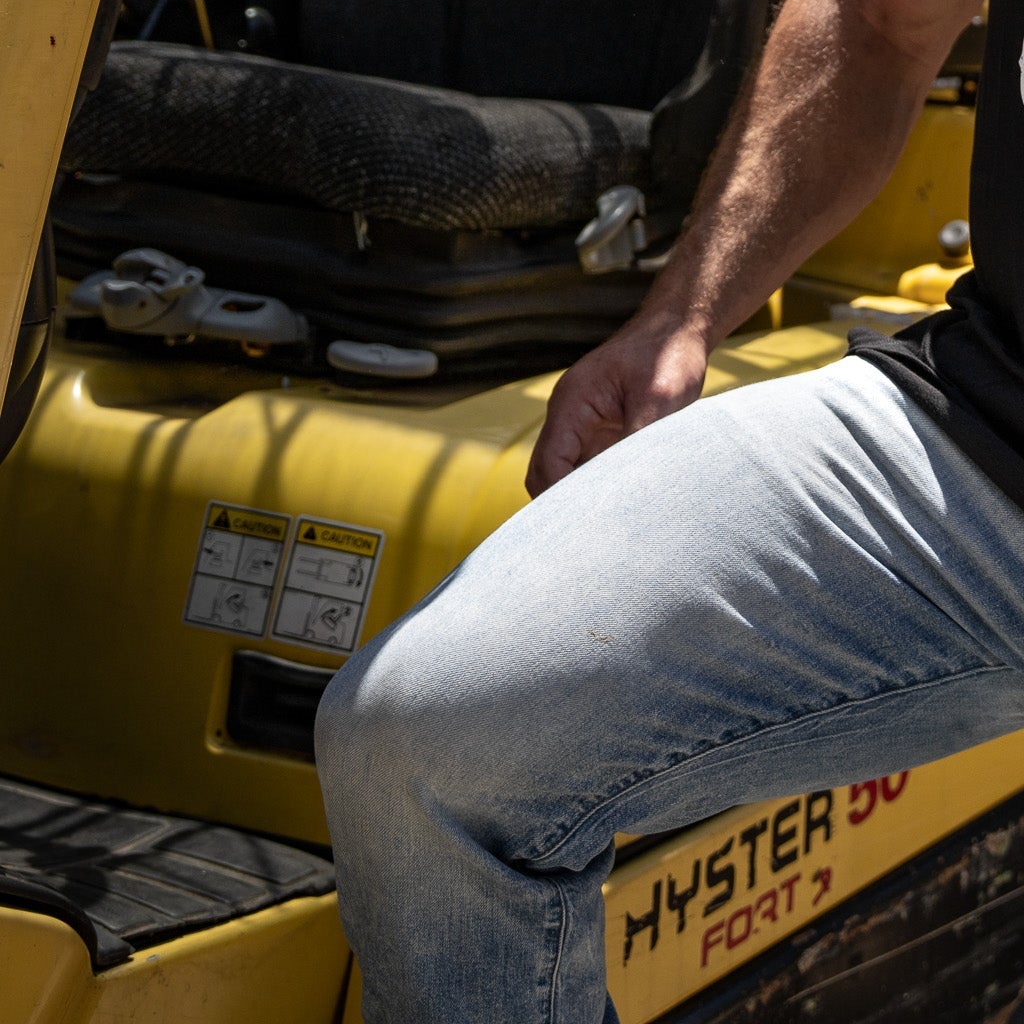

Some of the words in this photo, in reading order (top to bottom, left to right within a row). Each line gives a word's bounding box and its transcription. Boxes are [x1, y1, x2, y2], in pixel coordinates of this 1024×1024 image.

[233, 517, 281, 537] CAUTION
[320, 530, 372, 551] CAUTION
[623, 790, 835, 967] HYSTER
